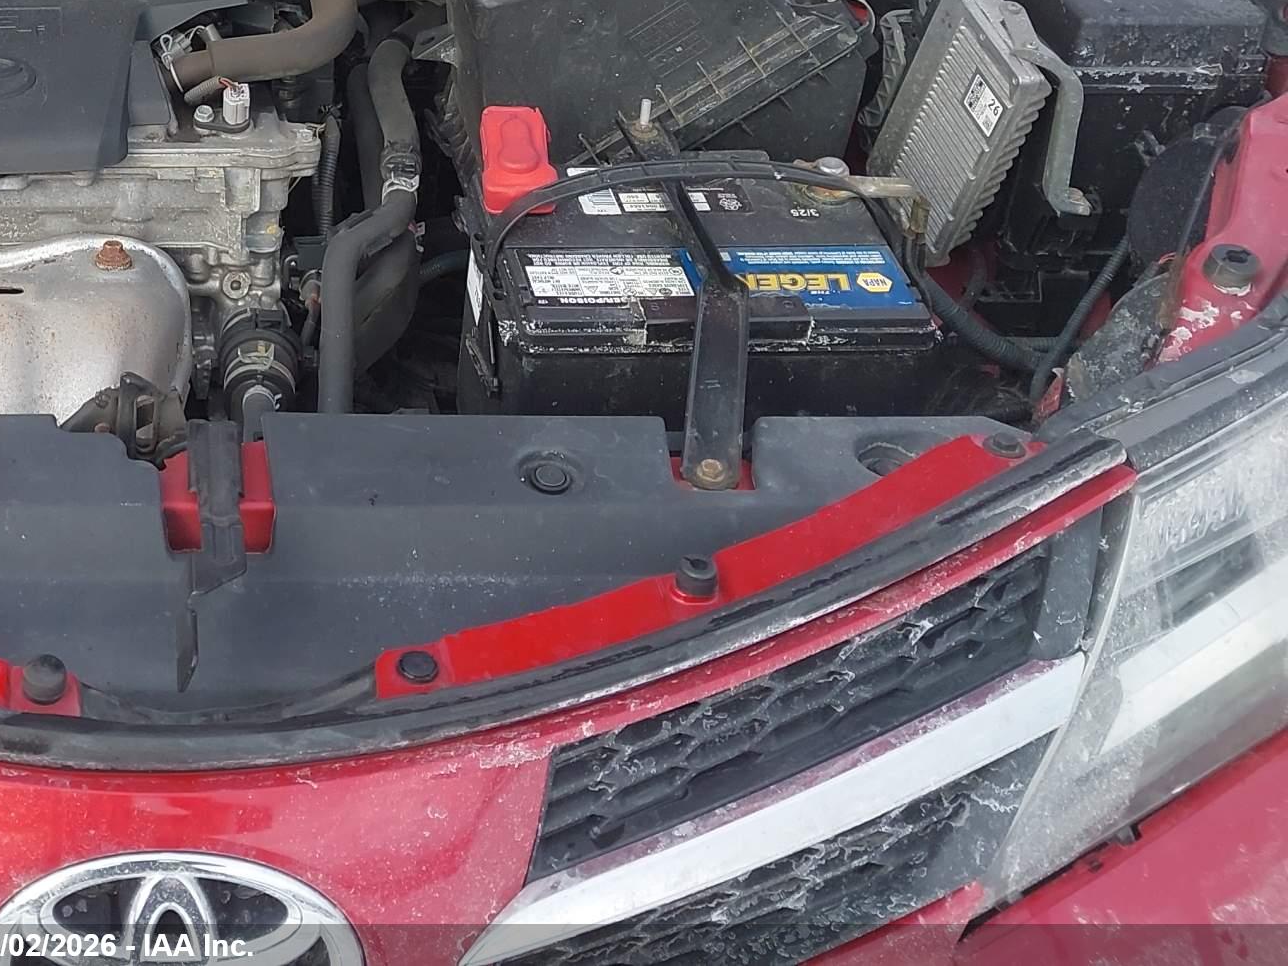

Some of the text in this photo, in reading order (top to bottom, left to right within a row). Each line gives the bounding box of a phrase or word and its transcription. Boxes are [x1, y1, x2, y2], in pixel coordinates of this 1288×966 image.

[987, 98, 1001, 117] 26
[790, 207, 820, 219] 3/25
[733, 273, 887, 291] NAPA LEGEN
